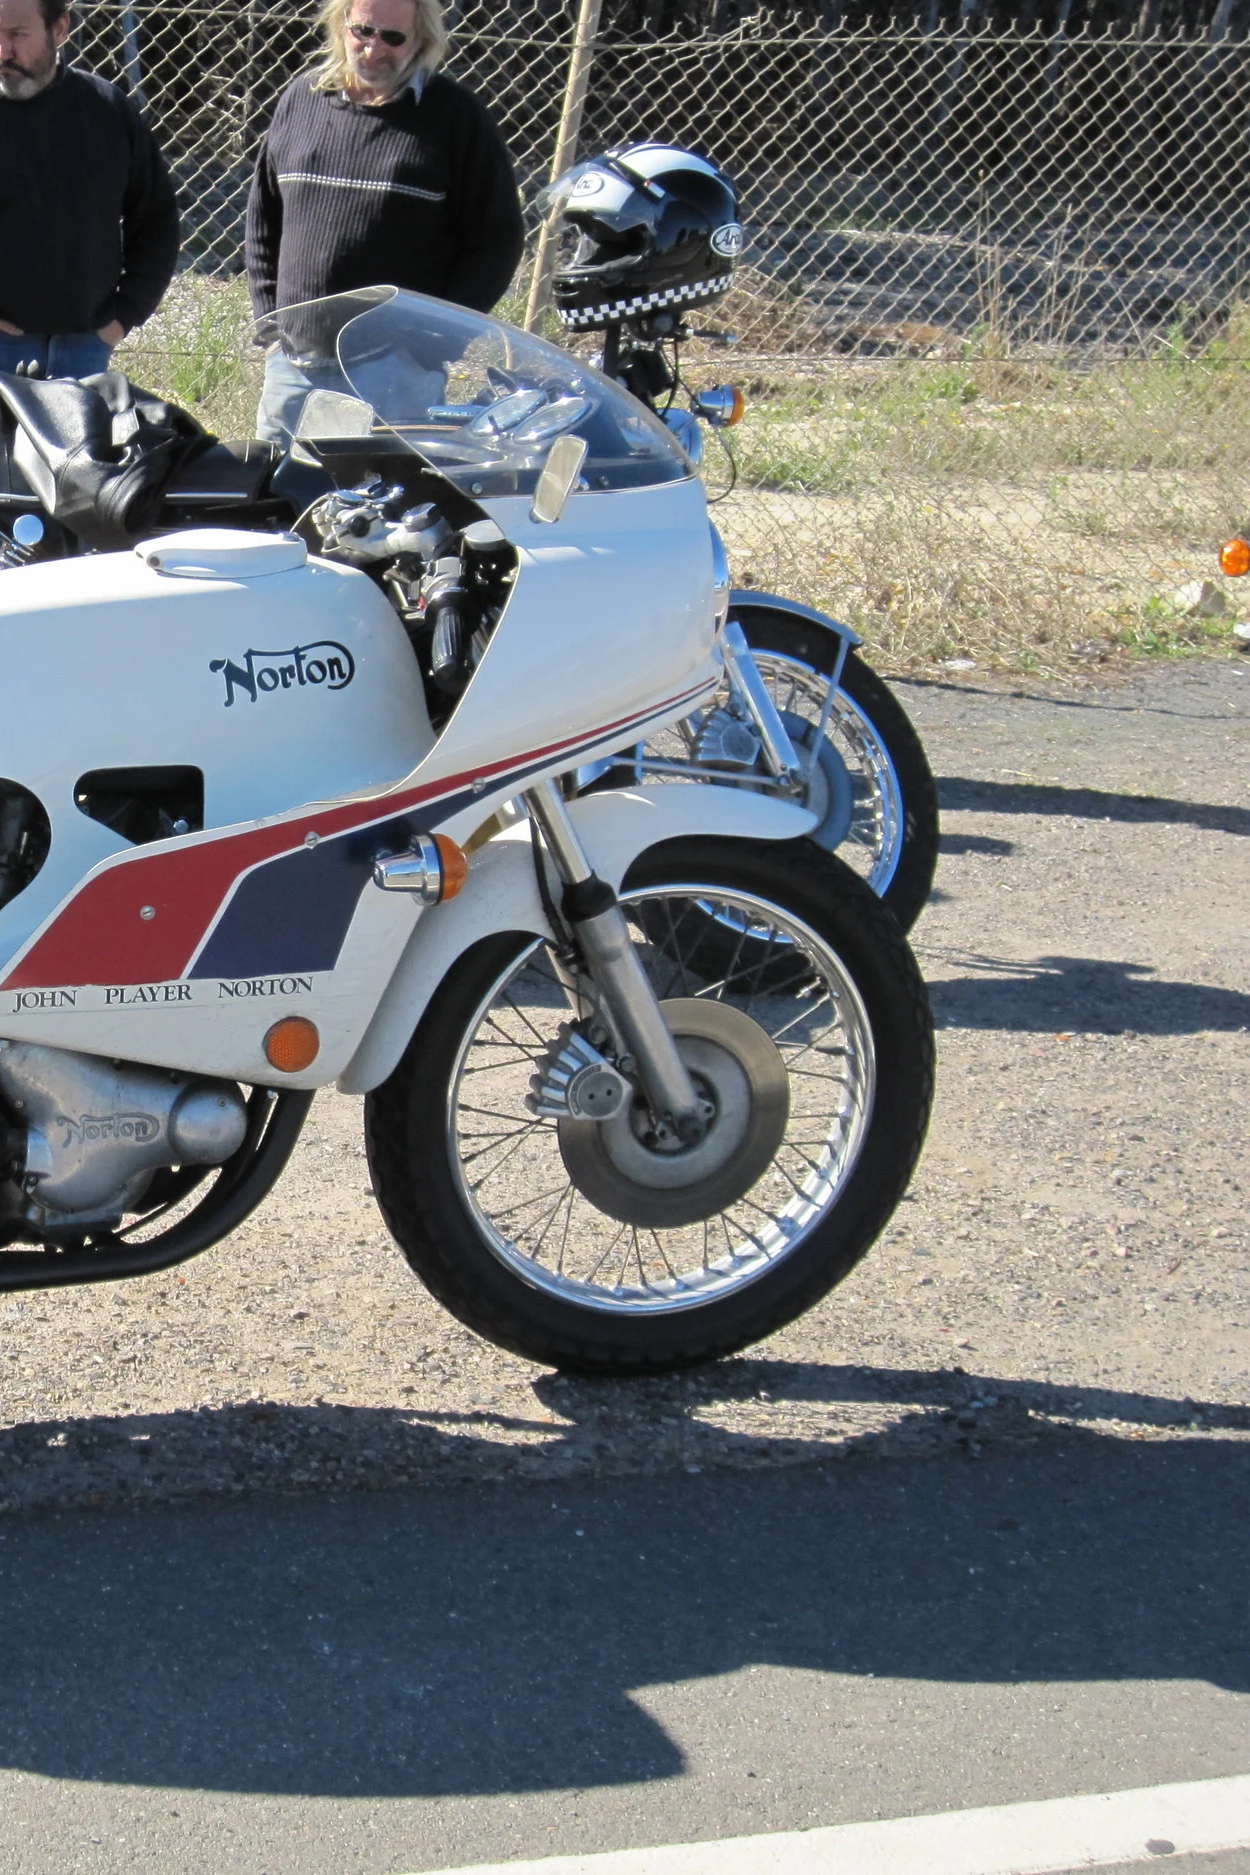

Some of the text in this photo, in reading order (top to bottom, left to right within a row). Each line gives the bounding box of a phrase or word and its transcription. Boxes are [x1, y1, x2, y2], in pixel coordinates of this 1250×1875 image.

[209, 640, 355, 707] Norton
[12, 976, 313, 1013] JOHN PLAYER NORTON
[57, 1111, 160, 1148] Norton
